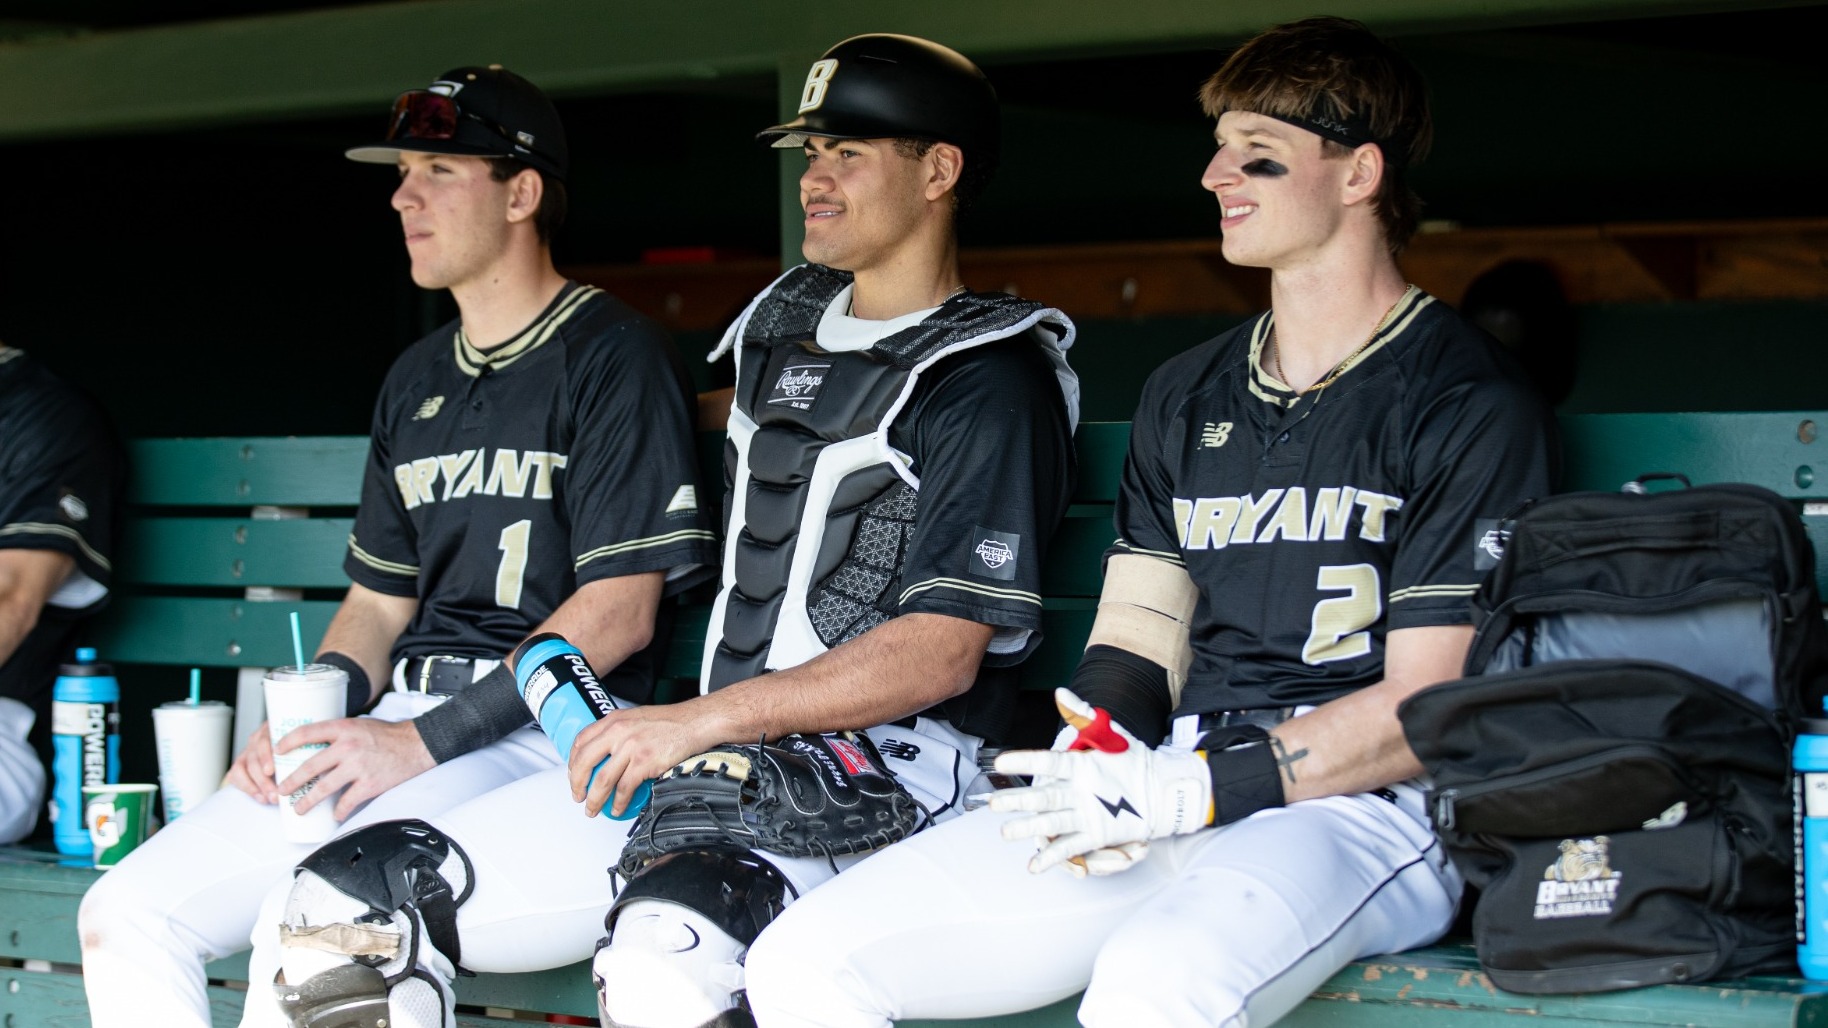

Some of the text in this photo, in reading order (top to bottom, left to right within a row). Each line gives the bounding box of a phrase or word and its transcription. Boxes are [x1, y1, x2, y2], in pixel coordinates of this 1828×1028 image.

[798, 58, 839, 114] B
[775, 369, 823, 394] Rawlings
[394, 446, 569, 511] BRYANT
[1172, 485, 1405, 550] BRYANT
[495, 519, 532, 610] 1
[977, 545, 1012, 559] AMERICA
[984, 552, 1004, 562] EAST
[1301, 563, 1382, 665] 2
[1536, 879, 1621, 904] BRYANT
